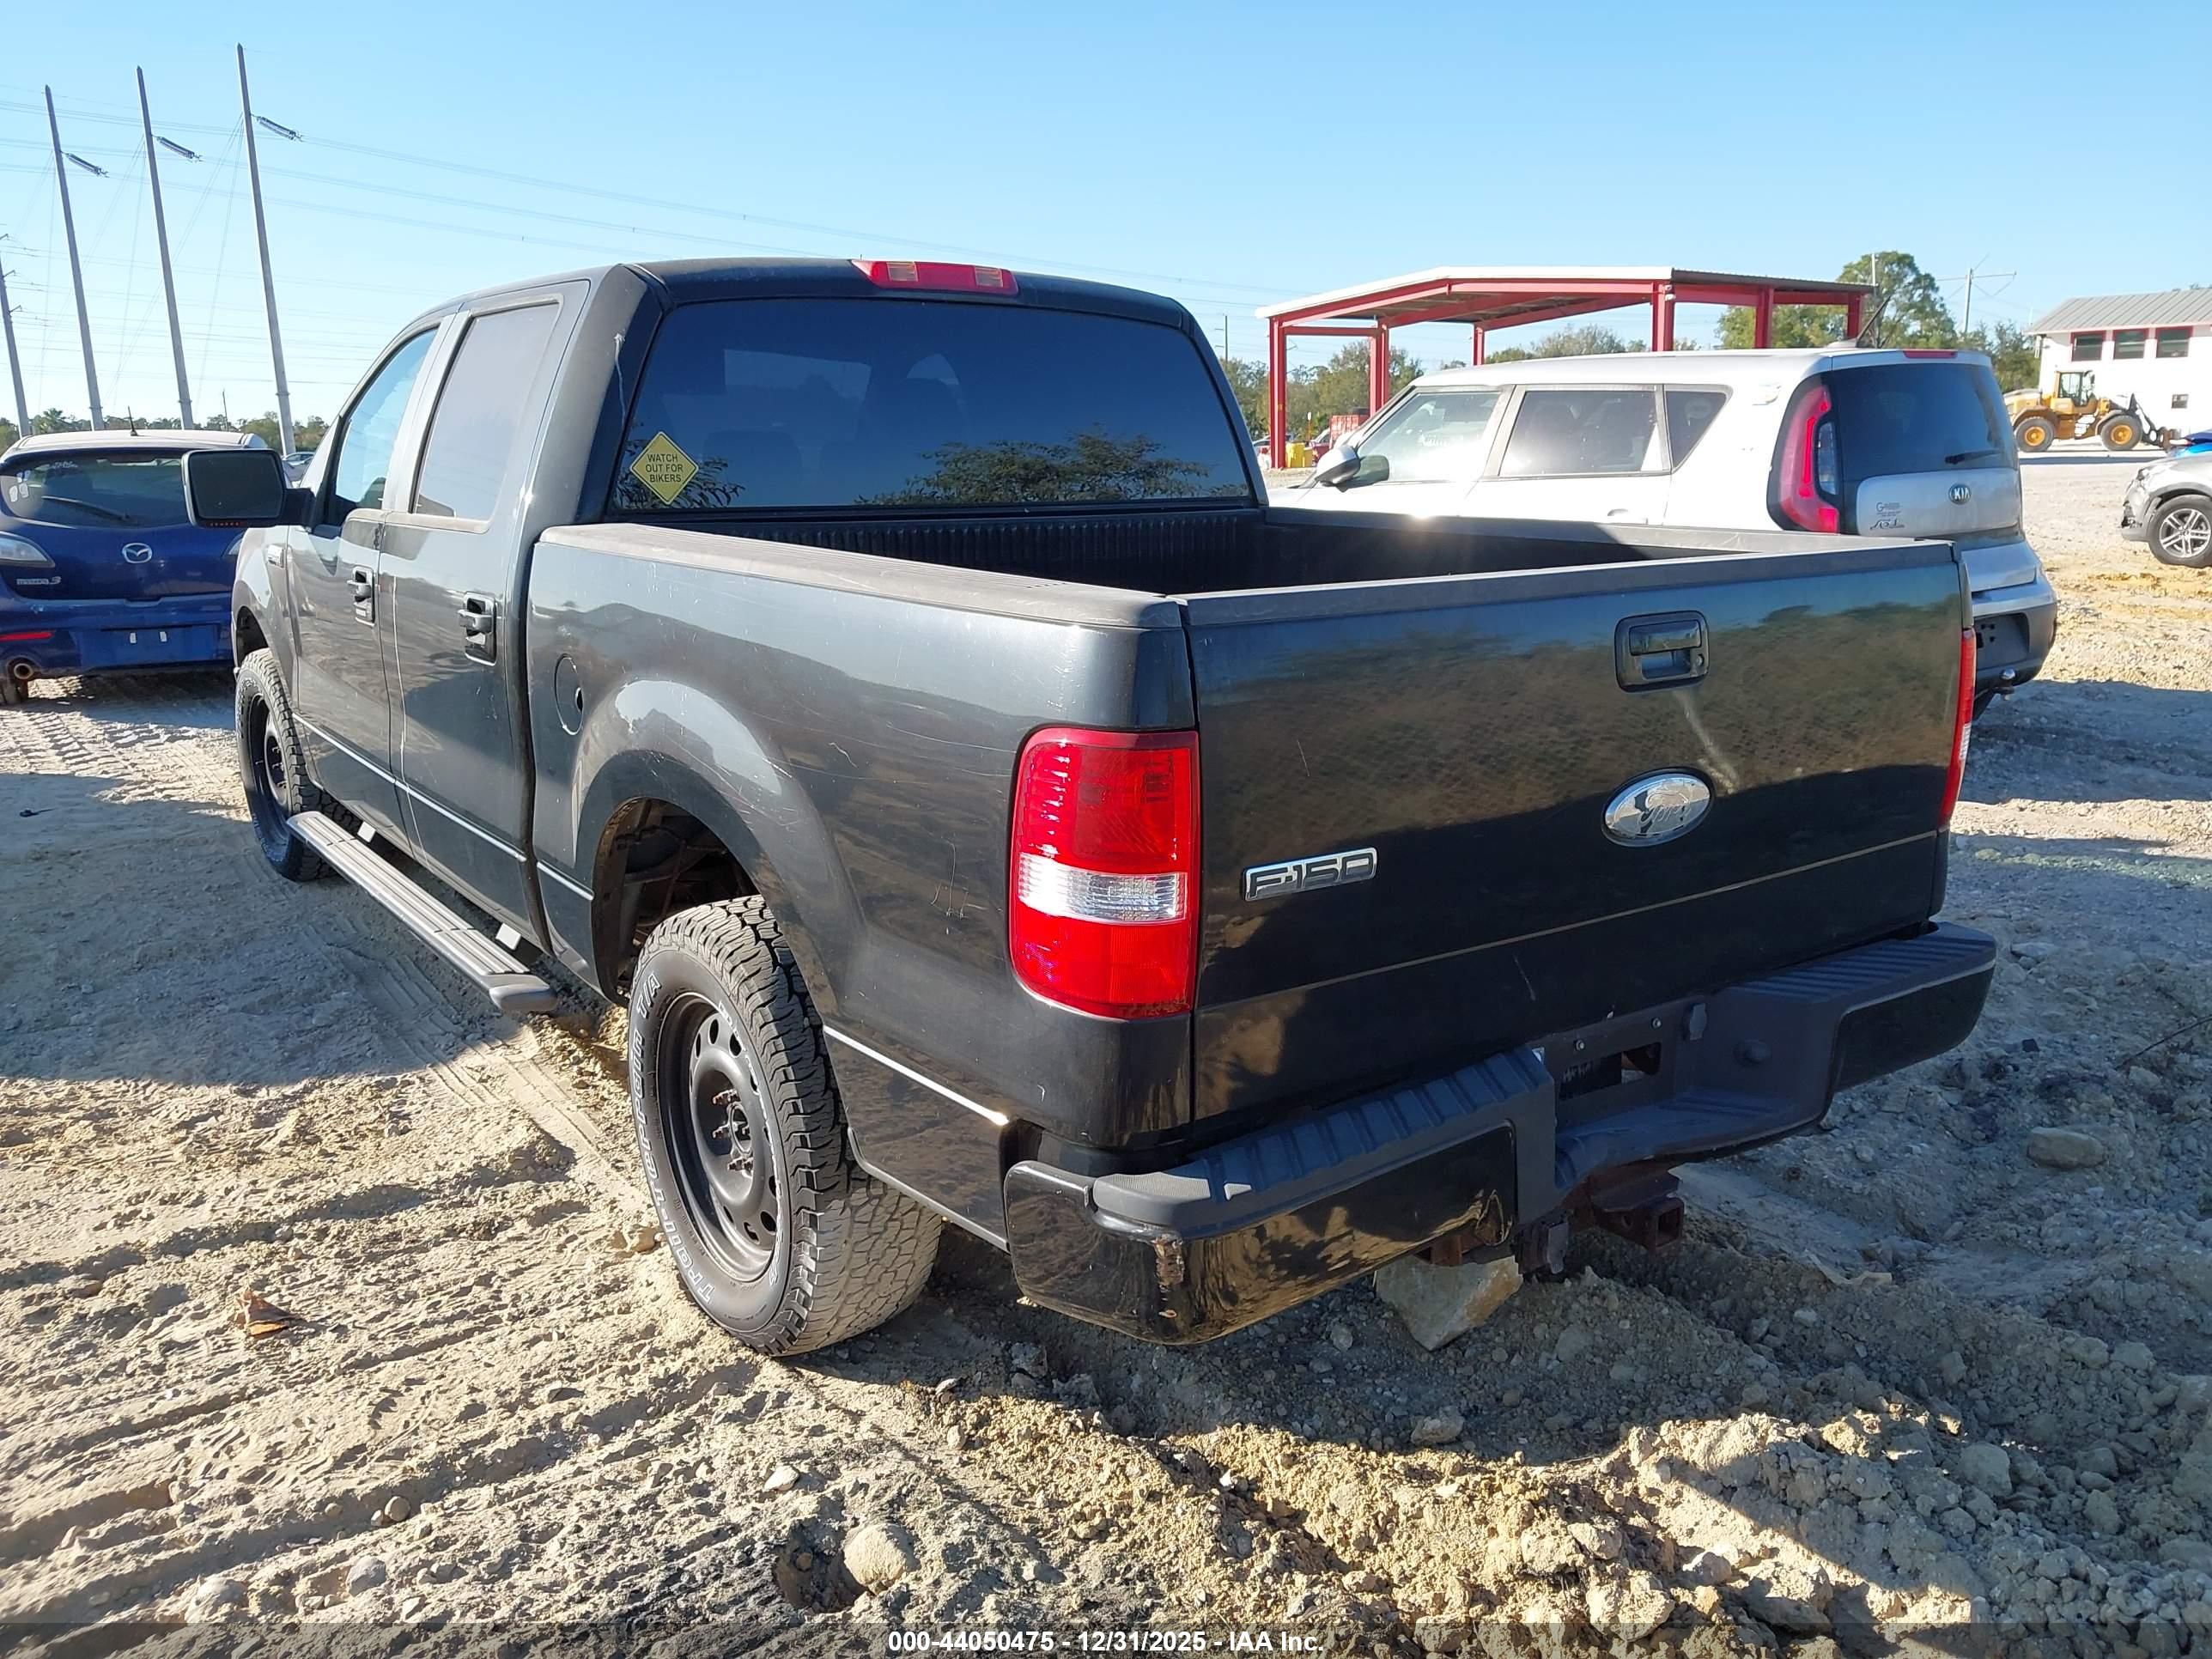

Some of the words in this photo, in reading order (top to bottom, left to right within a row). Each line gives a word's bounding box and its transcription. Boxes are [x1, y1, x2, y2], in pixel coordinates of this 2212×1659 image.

[647, 453, 678, 463] WATCH
[645, 464, 663, 472] OUT
[665, 464, 684, 472] FOR
[649, 473, 682, 483] BIKERS
[1954, 487, 1970, 500] KIA
[1248, 850, 1376, 899] F-150
[636, 972, 662, 1019] T/A
